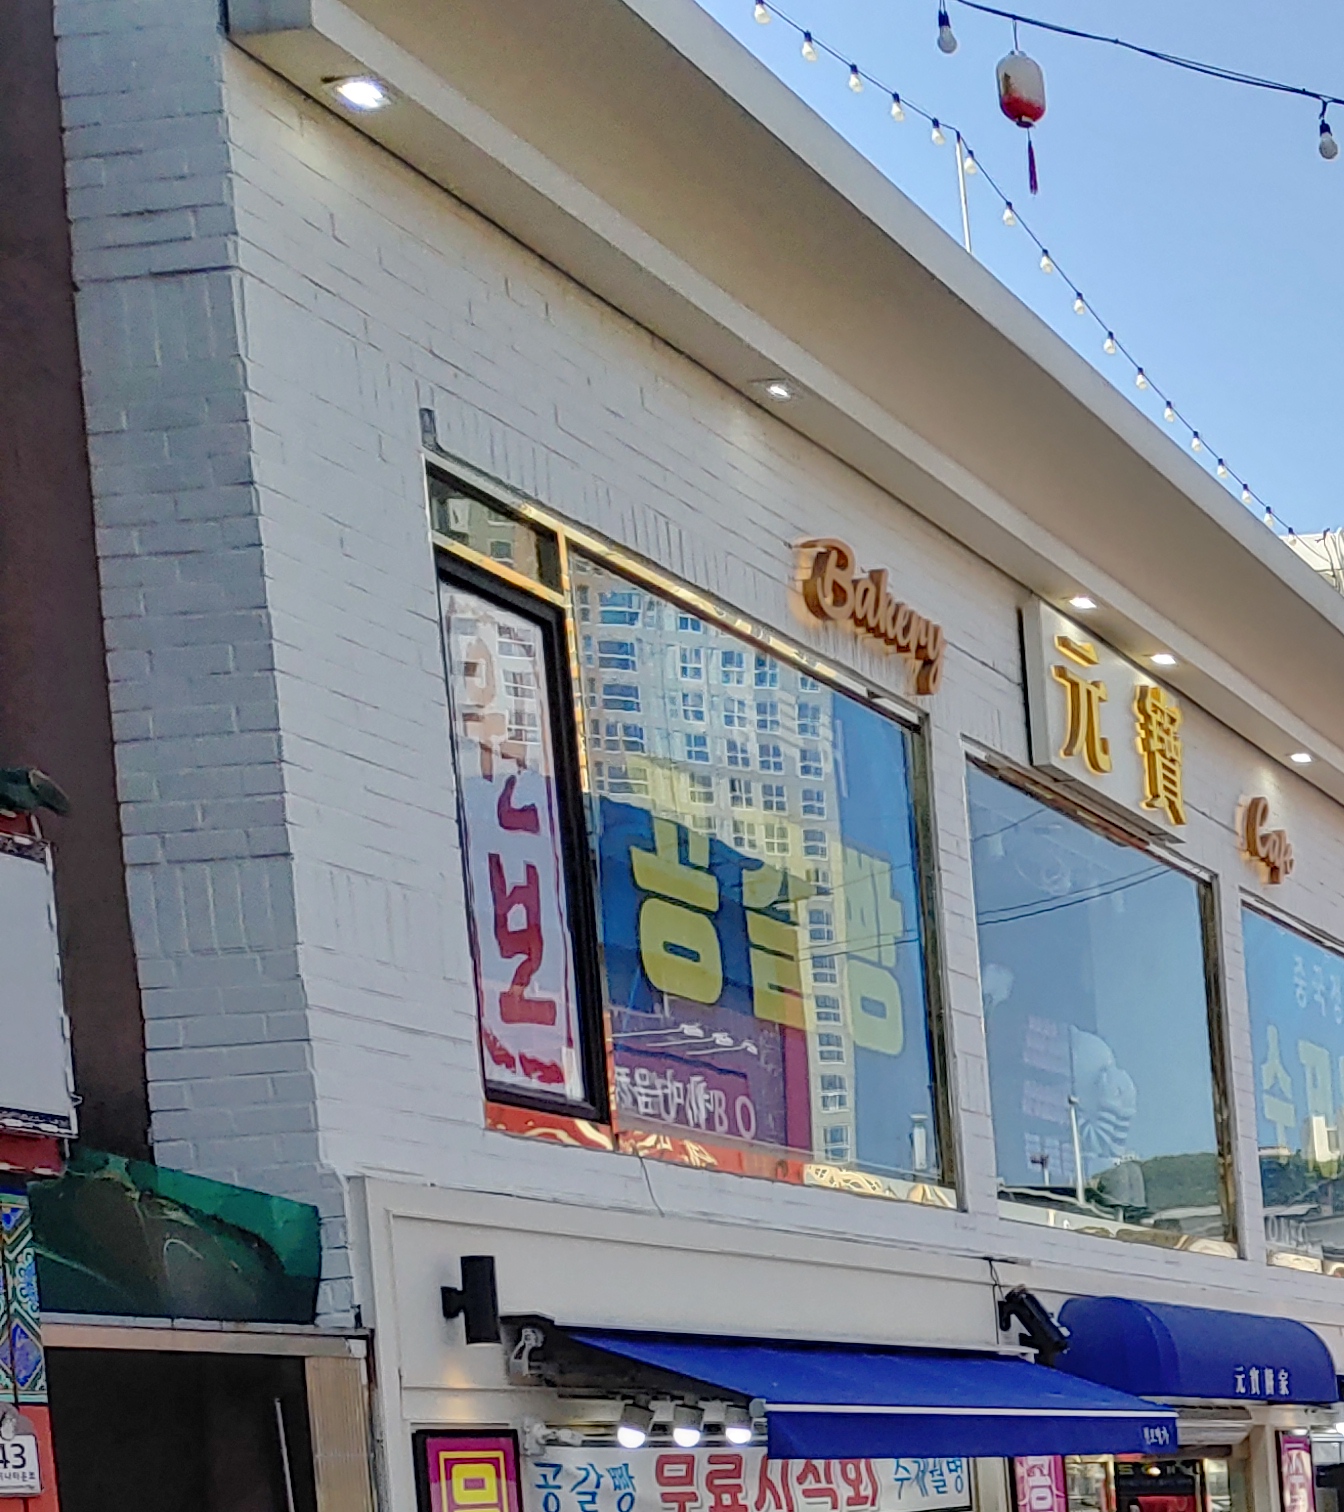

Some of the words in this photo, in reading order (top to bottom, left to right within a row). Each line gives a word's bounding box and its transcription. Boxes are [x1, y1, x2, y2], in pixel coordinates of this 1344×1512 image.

[800, 538, 944, 695] Bakery
[1052, 635, 1188, 826] 元寶
[1236, 796, 1296, 886] Cafe
